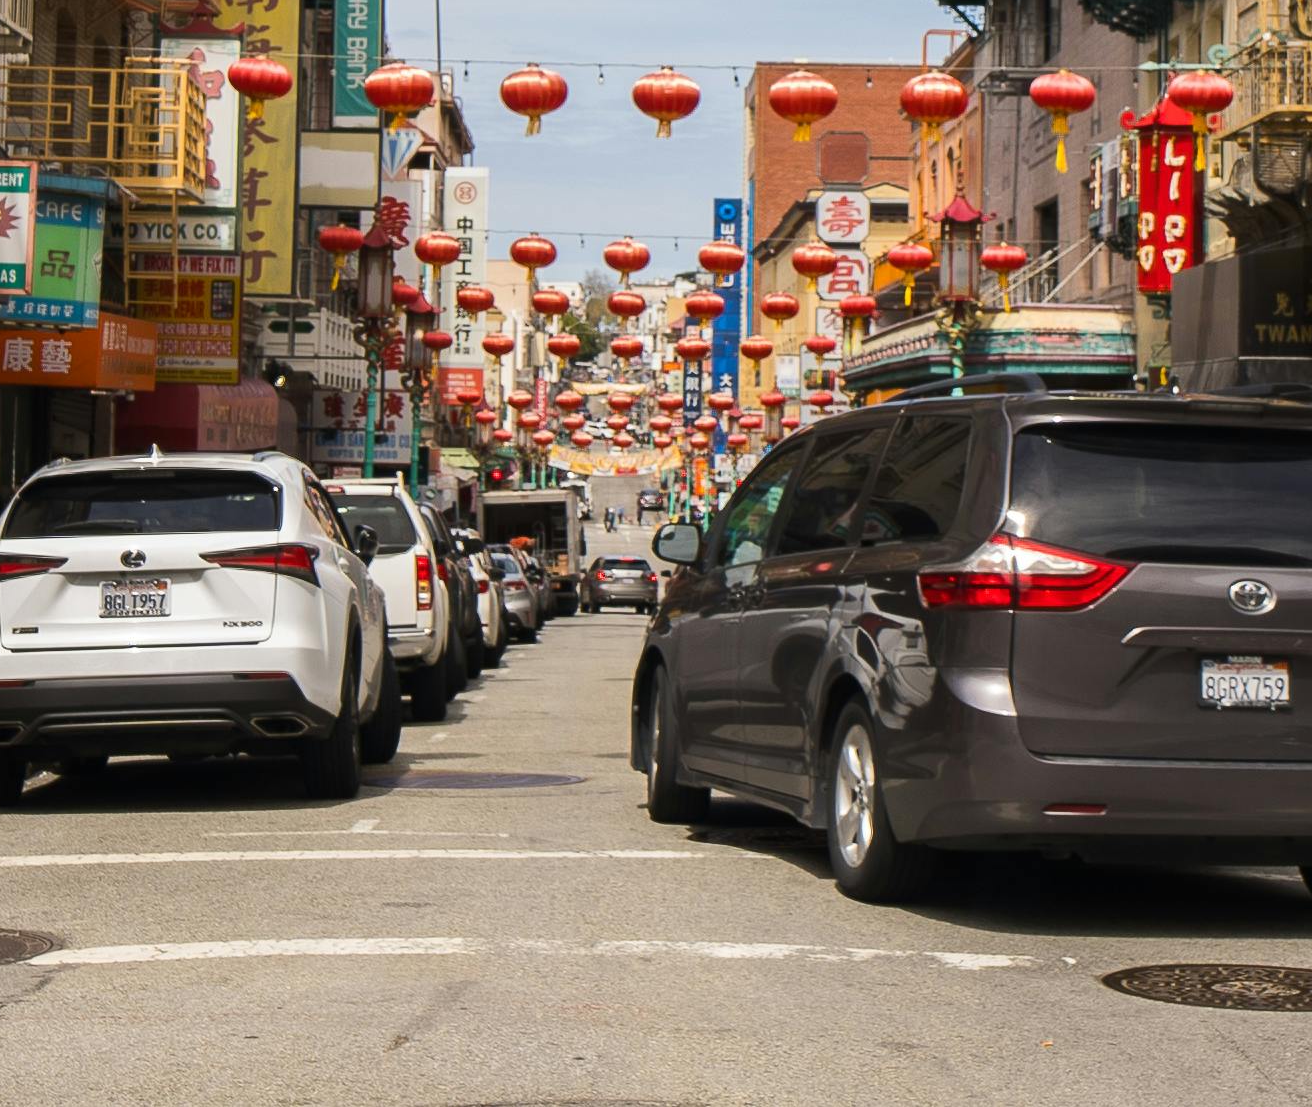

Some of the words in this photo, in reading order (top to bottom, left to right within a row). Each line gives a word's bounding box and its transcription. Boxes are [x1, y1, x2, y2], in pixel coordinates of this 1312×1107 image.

[346, 37, 368, 90] BANK
[193, 223, 221, 240] CO.
[1206, 676, 1285, 702] 8GRX759
